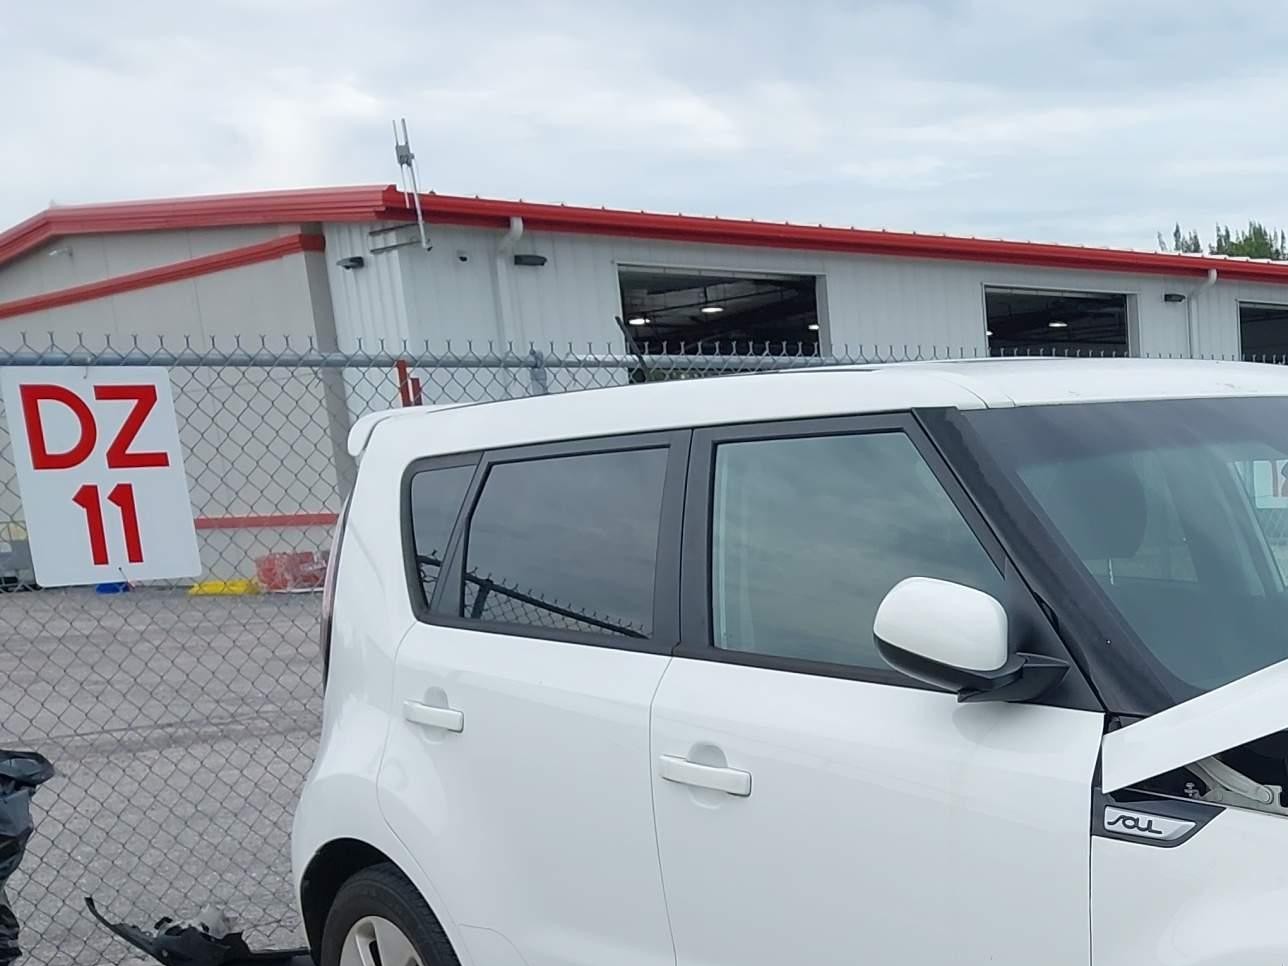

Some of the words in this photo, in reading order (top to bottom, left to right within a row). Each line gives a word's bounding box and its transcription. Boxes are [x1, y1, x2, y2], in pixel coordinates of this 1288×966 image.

[19, 383, 170, 470] DZ
[71, 483, 144, 565] 11
[1106, 814, 1163, 835] SOUL
